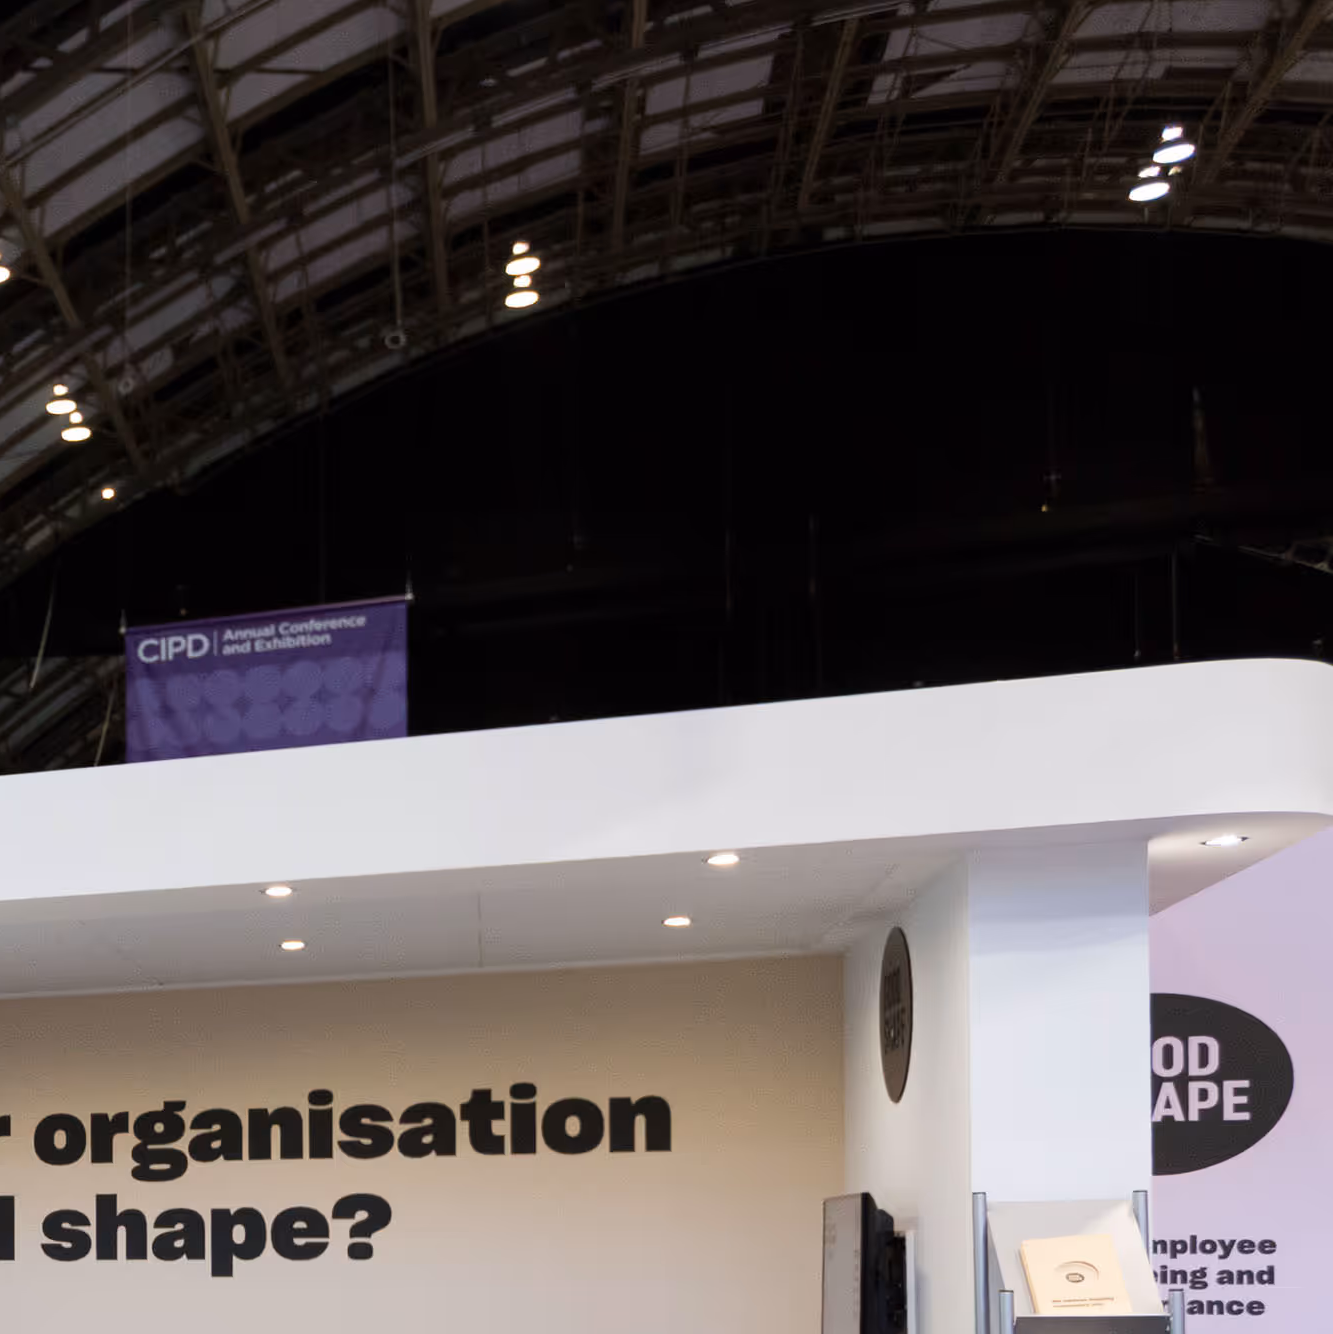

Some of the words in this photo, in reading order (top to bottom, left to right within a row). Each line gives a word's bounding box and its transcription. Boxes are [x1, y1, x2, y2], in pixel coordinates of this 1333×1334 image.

[222, 623, 276, 642] Annual
[278, 615, 367, 636] Conference
[222, 639, 252, 656] and
[254, 632, 332, 653] Exhibition
[137, 633, 211, 664] CIPD
[1151, 1035, 1220, 1078] OD
[1151, 1079, 1251, 1122] APE
[32, 1082, 673, 1183] organisation
[39, 1192, 393, 1279] shape?
[1215, 1264, 1276, 1286] and
